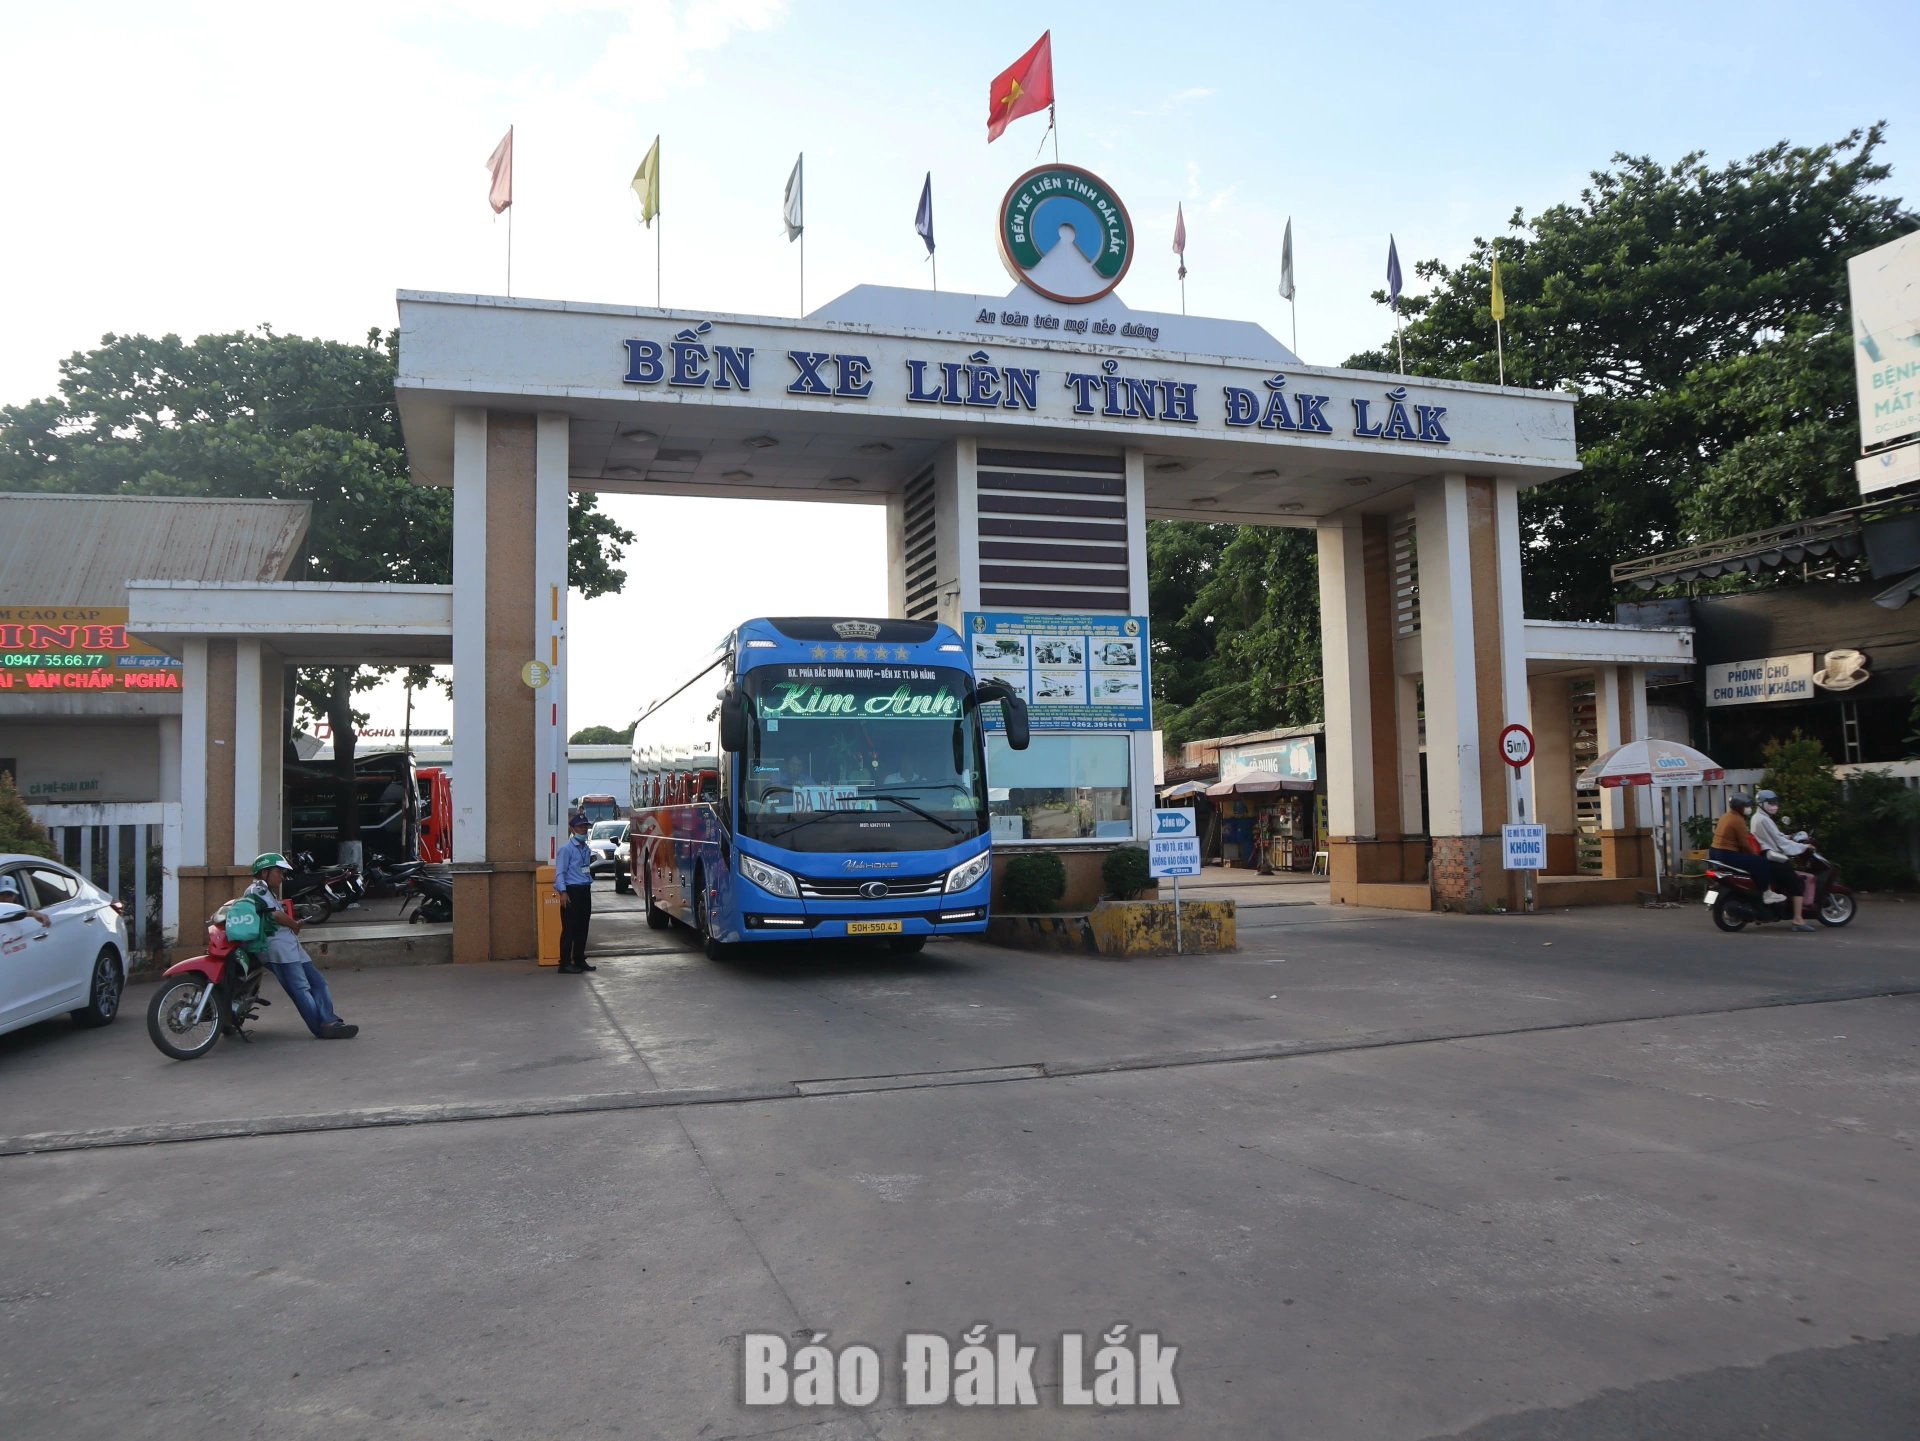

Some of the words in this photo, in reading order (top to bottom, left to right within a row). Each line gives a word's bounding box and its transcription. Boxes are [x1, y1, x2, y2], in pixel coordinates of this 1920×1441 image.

[1032, 177, 1062, 195] LIÊN
[1066, 178, 1097, 200] TỈNH
[1017, 193, 1033, 212] XE
[1097, 199, 1118, 226] ĐẮK
[1011, 215, 1025, 243] BẾN
[1109, 229, 1124, 255] LẮK
[976, 309, 996, 323] An
[1001, 311, 1029, 326] toàn
[1034, 314, 1059, 330] trên
[1064, 318, 1088, 334] mọi
[1121, 321, 1159, 342] đường
[623, 320, 755, 391] BẾN
[787, 349, 874, 398] XE
[906, 350, 1040, 410] LIÊN
[1064, 359, 1199, 423] TỈNH
[1224, 373, 1333, 434] ĐẮK
[1353, 386, 1451, 444] LẮK
[18, 611, 57, 620] CAO
[63, 668, 114, 688] CHẤN
[125, 668, 178, 688] NGHĨA
[531, 663, 541, 686] STOP
[1728, 667, 1763, 683] PHÒNG
[1767, 664, 1789, 679] CHỜ
[762, 682, 857, 714] Kim
[864, 682, 958, 714] Anh
[1714, 688, 1733, 700] CHO
[1737, 681, 1764, 698] HÀNH
[1768, 680, 1806, 695] KHÁCH
[1658, 758, 1686, 768] OMO
[1510, 839, 1540, 854] KHÔNG
[257, 859, 269, 867] Grab
[851, 922, 898, 933] 50H-550.43
